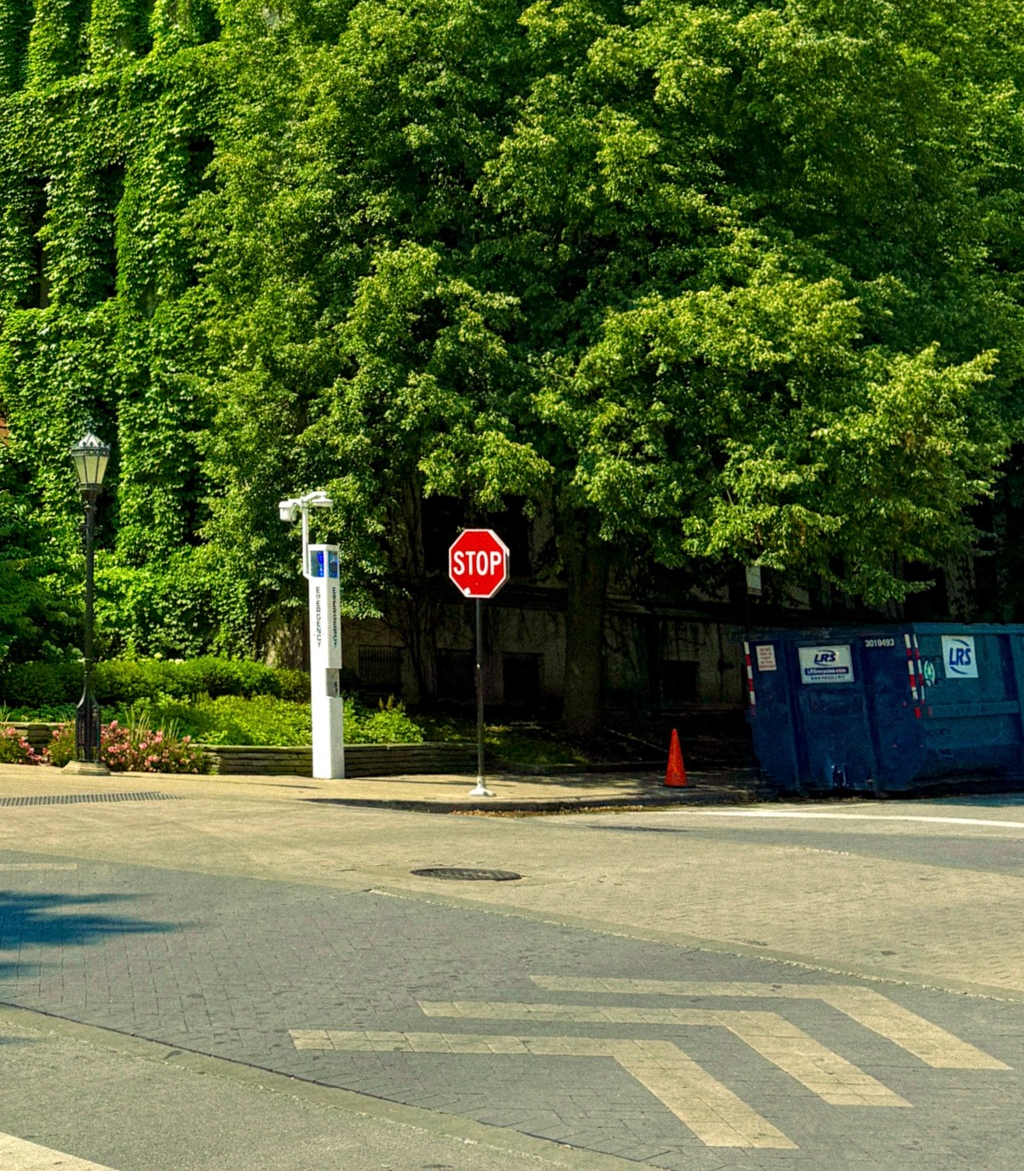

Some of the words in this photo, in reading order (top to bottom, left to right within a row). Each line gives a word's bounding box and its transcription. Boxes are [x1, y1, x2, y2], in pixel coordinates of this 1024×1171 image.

[453, 550, 502, 576] STOP
[813, 653, 836, 663] LRS
[949, 647, 972, 666] LRS
